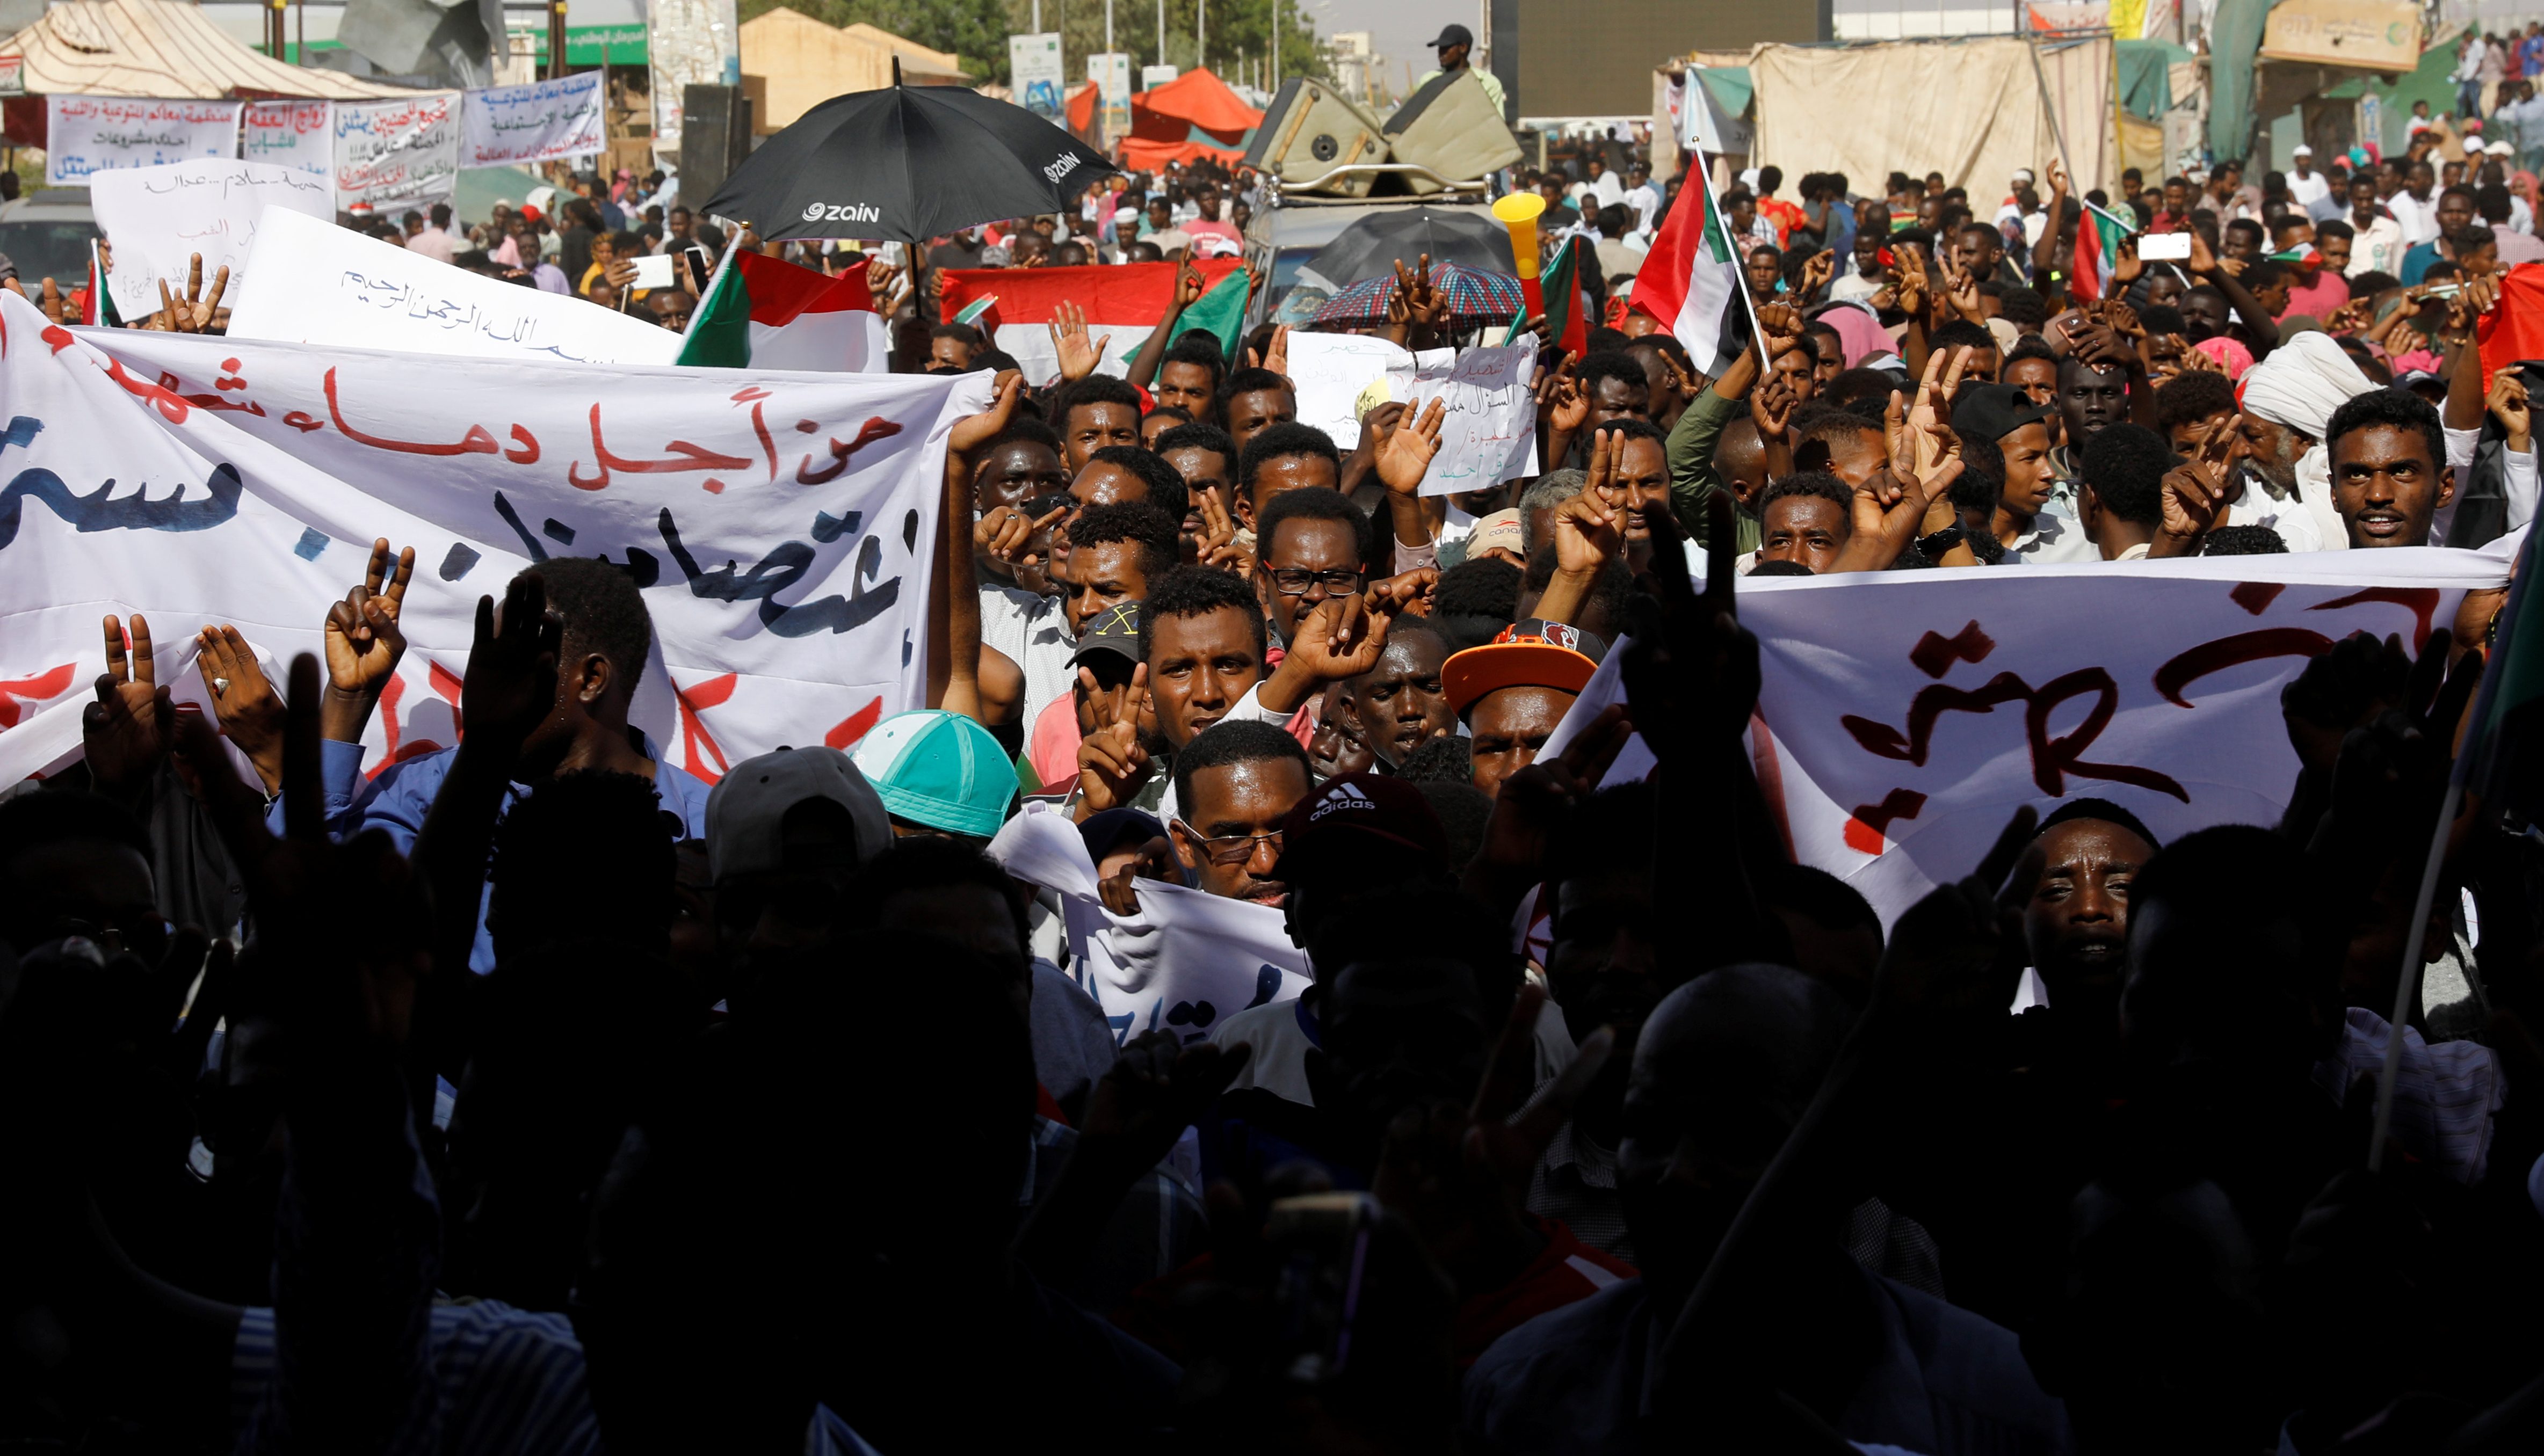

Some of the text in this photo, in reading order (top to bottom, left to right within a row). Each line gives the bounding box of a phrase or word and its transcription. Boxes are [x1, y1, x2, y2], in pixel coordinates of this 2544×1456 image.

[825, 202, 880, 223] zain
[341, 270, 416, 309] الرحيم
[409, 294, 482, 333] الرحمن
[482, 316, 538, 343] الله
[282, 365, 541, 465] دماء
[568, 385, 779, 494] أجل
[793, 415, 904, 485] من
[1310, 799, 1375, 821] adidas
